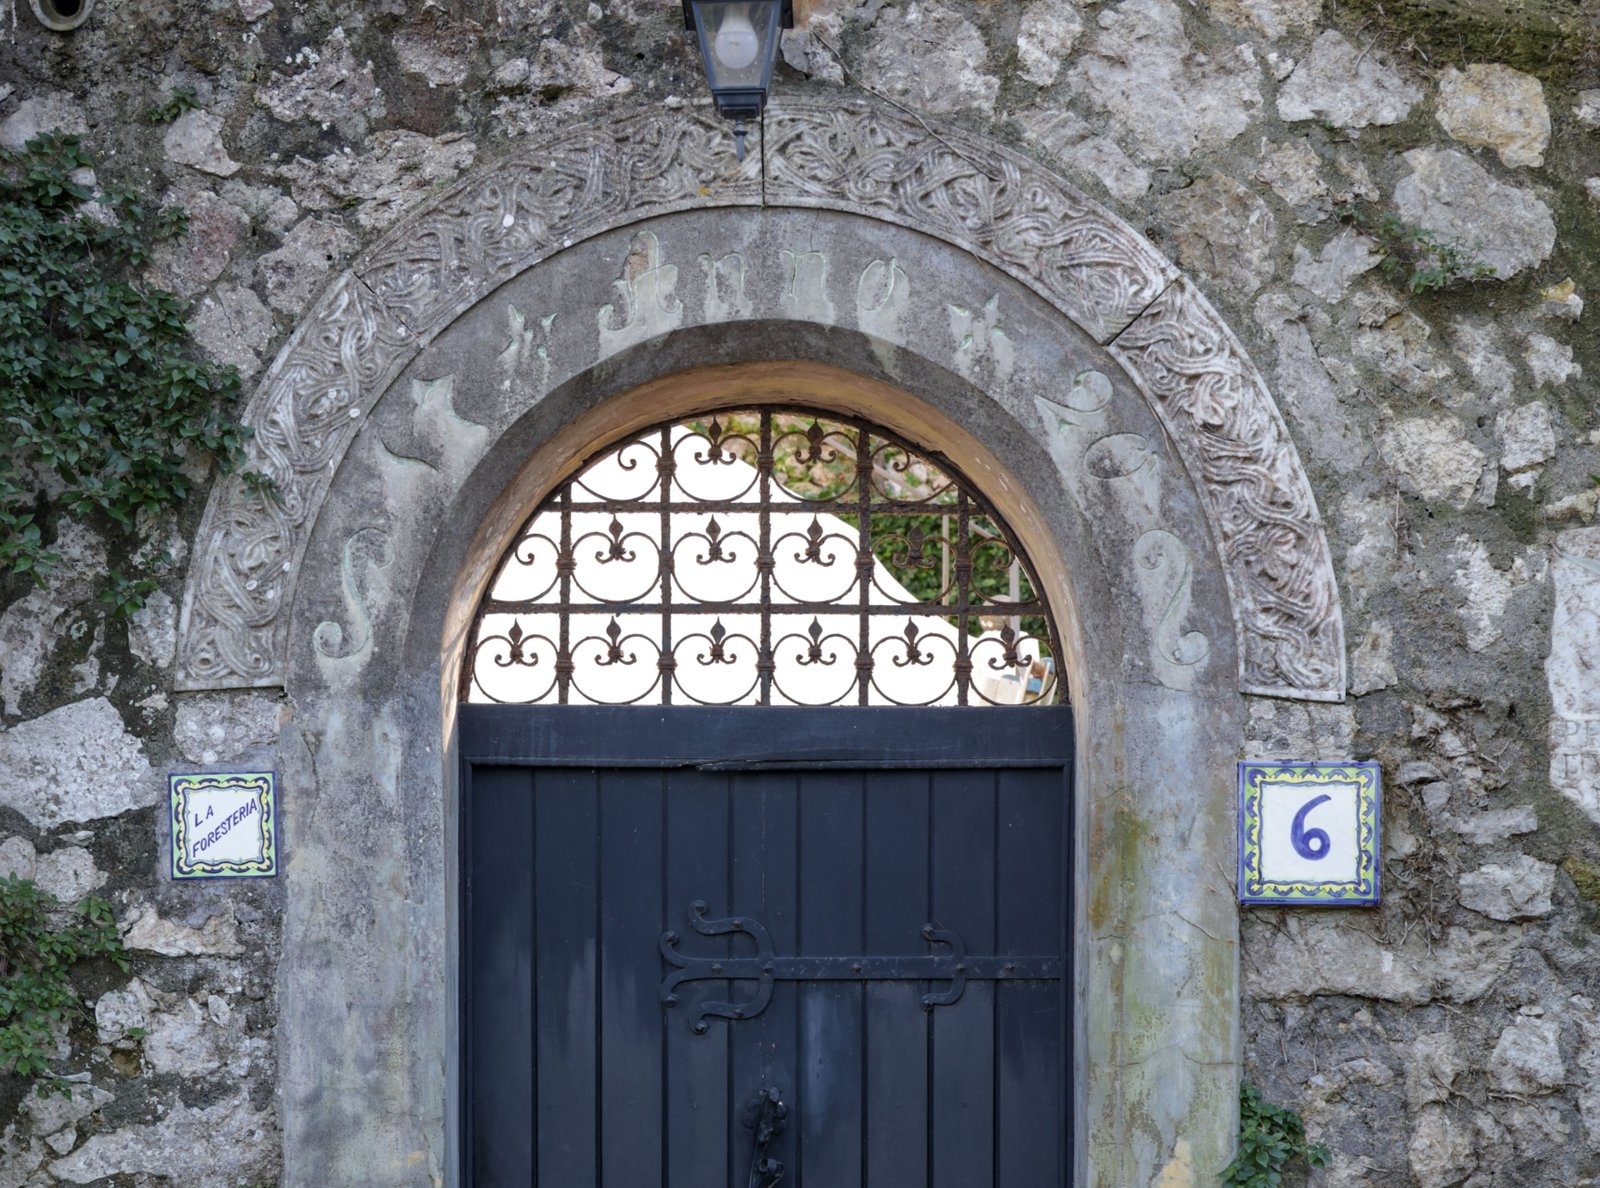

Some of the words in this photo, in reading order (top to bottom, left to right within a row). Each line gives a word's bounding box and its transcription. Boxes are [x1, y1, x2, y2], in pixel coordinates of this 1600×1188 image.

[192, 798, 258, 858] FORESTERIA
[194, 804, 214, 828] LA
[1290, 794, 1331, 861] 6
